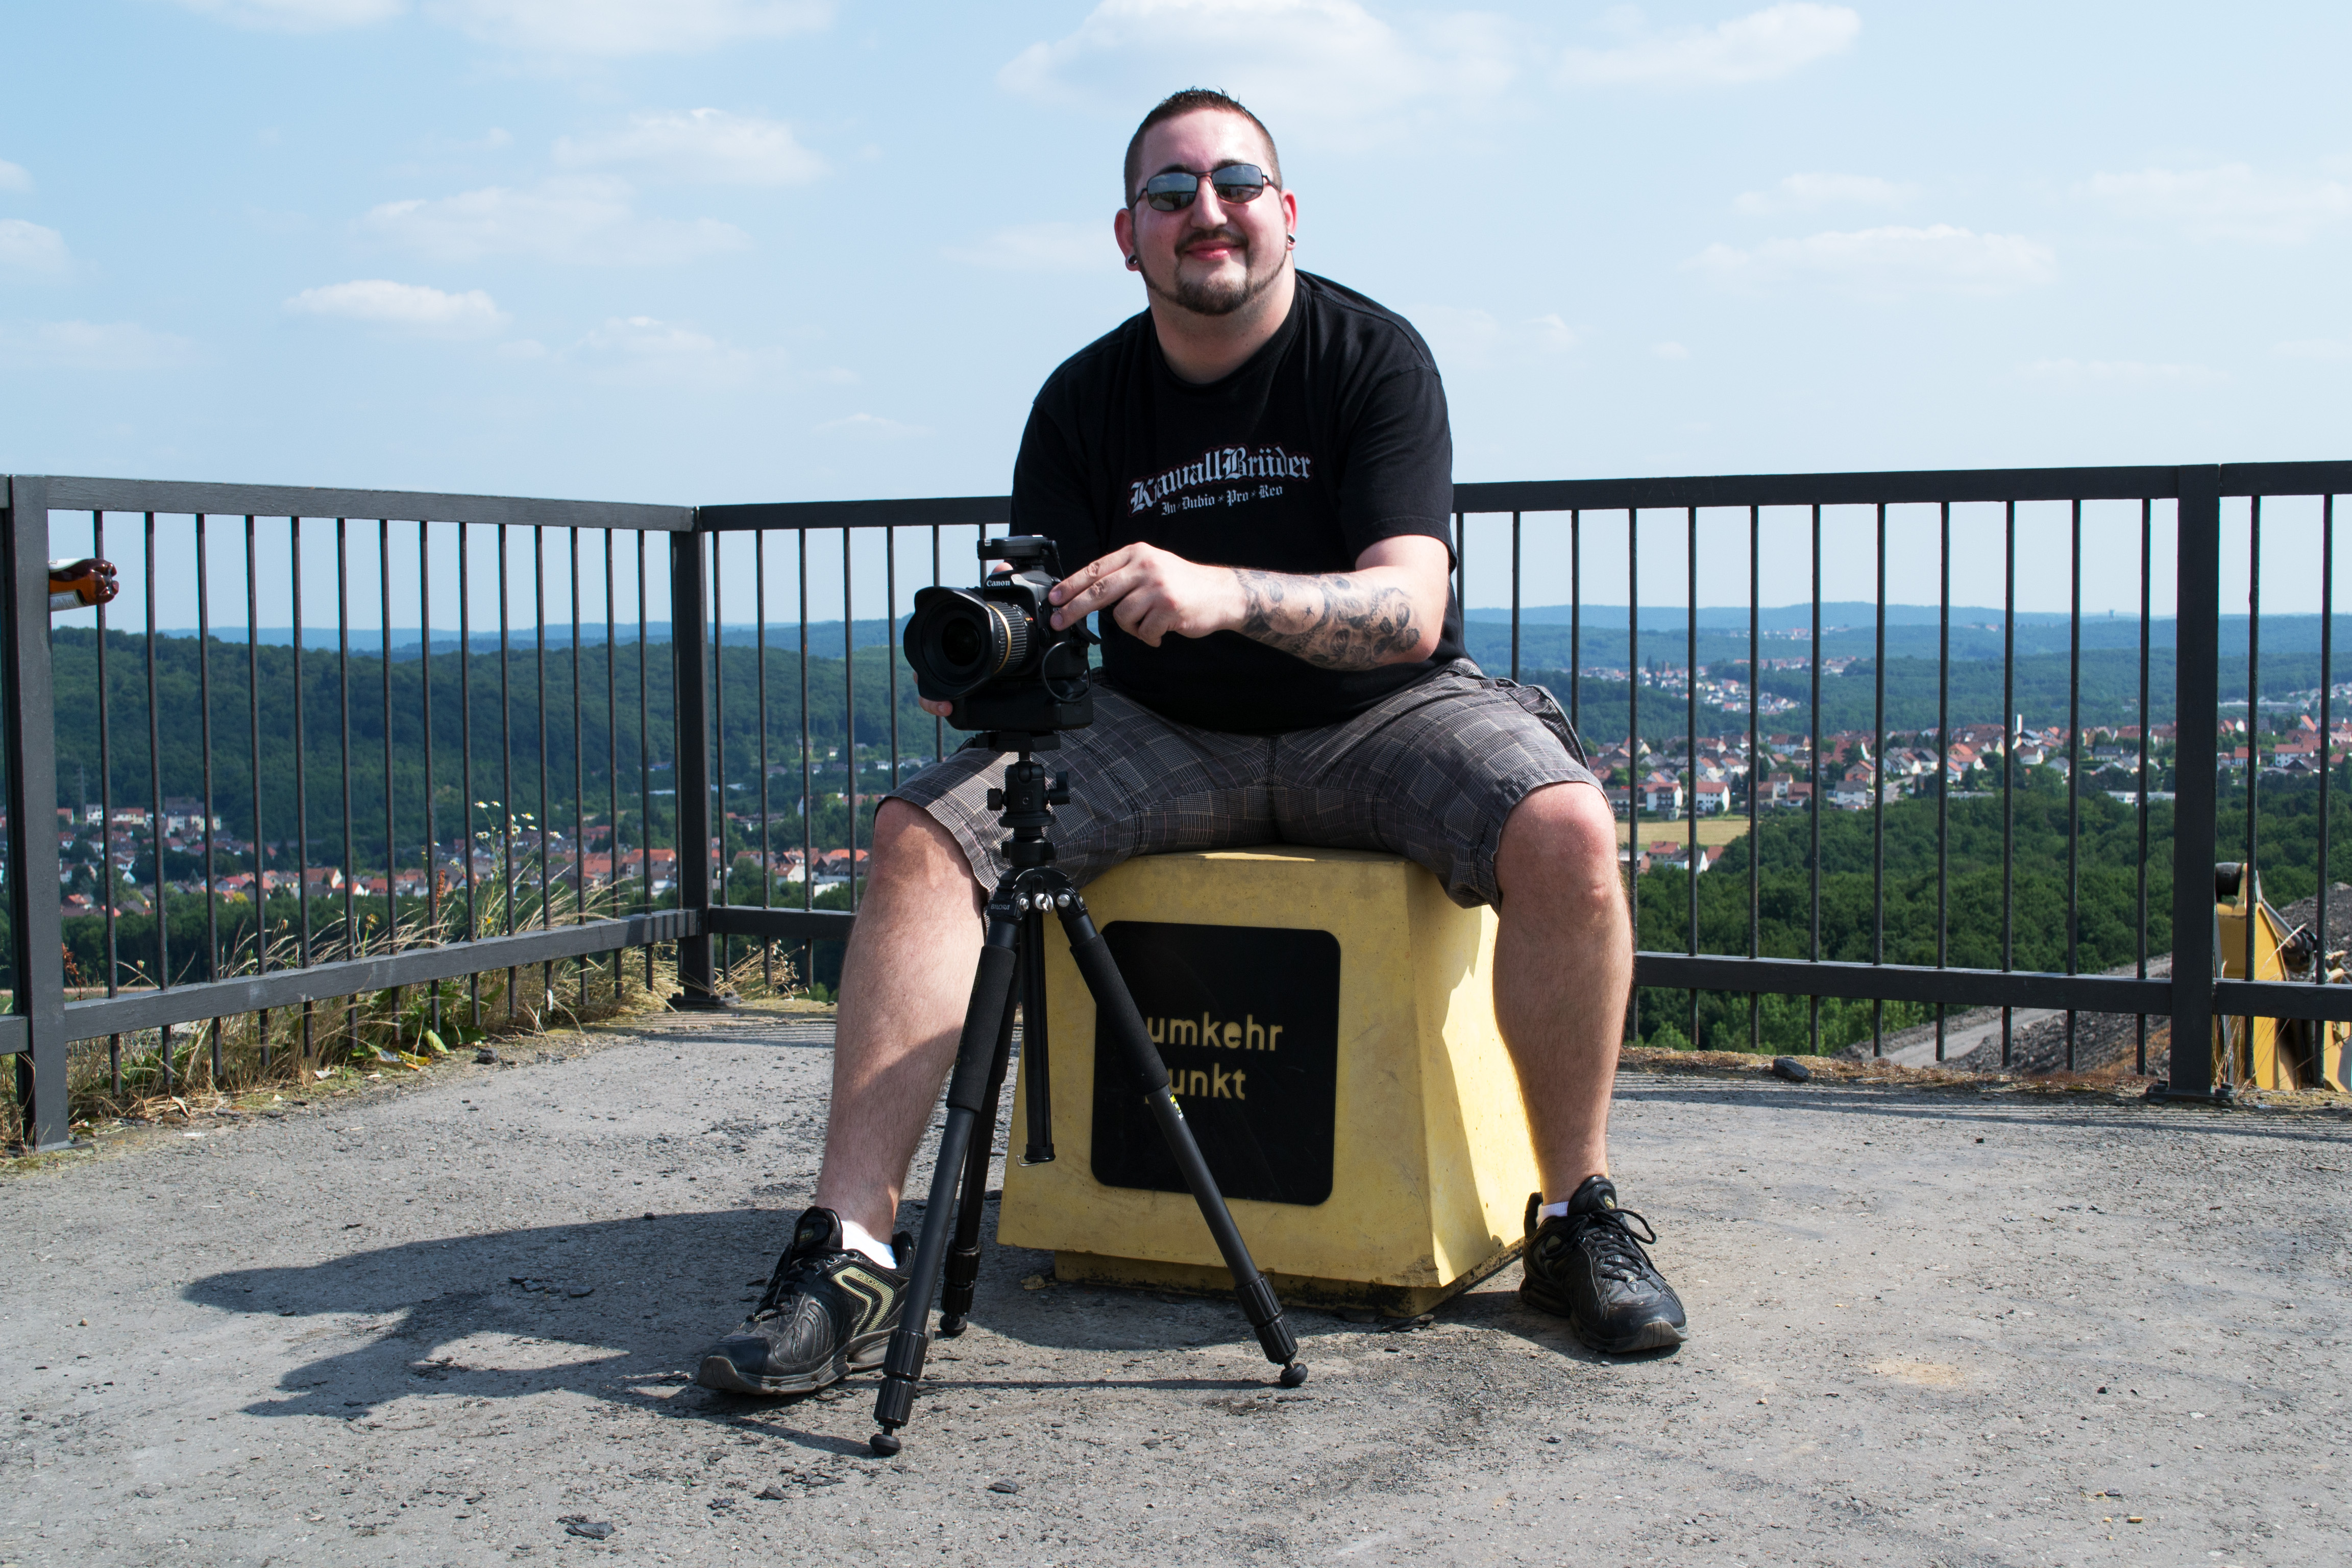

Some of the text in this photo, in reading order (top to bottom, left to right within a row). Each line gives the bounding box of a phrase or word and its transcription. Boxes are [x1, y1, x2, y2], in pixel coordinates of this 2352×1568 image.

[1161, 484, 1283, 516] In Dubio Pro Reo
[1146, 1011, 1283, 1051] umkehr
[1145, 1062, 1246, 1105] unkt
[856, 1271, 880, 1288] GEOX
